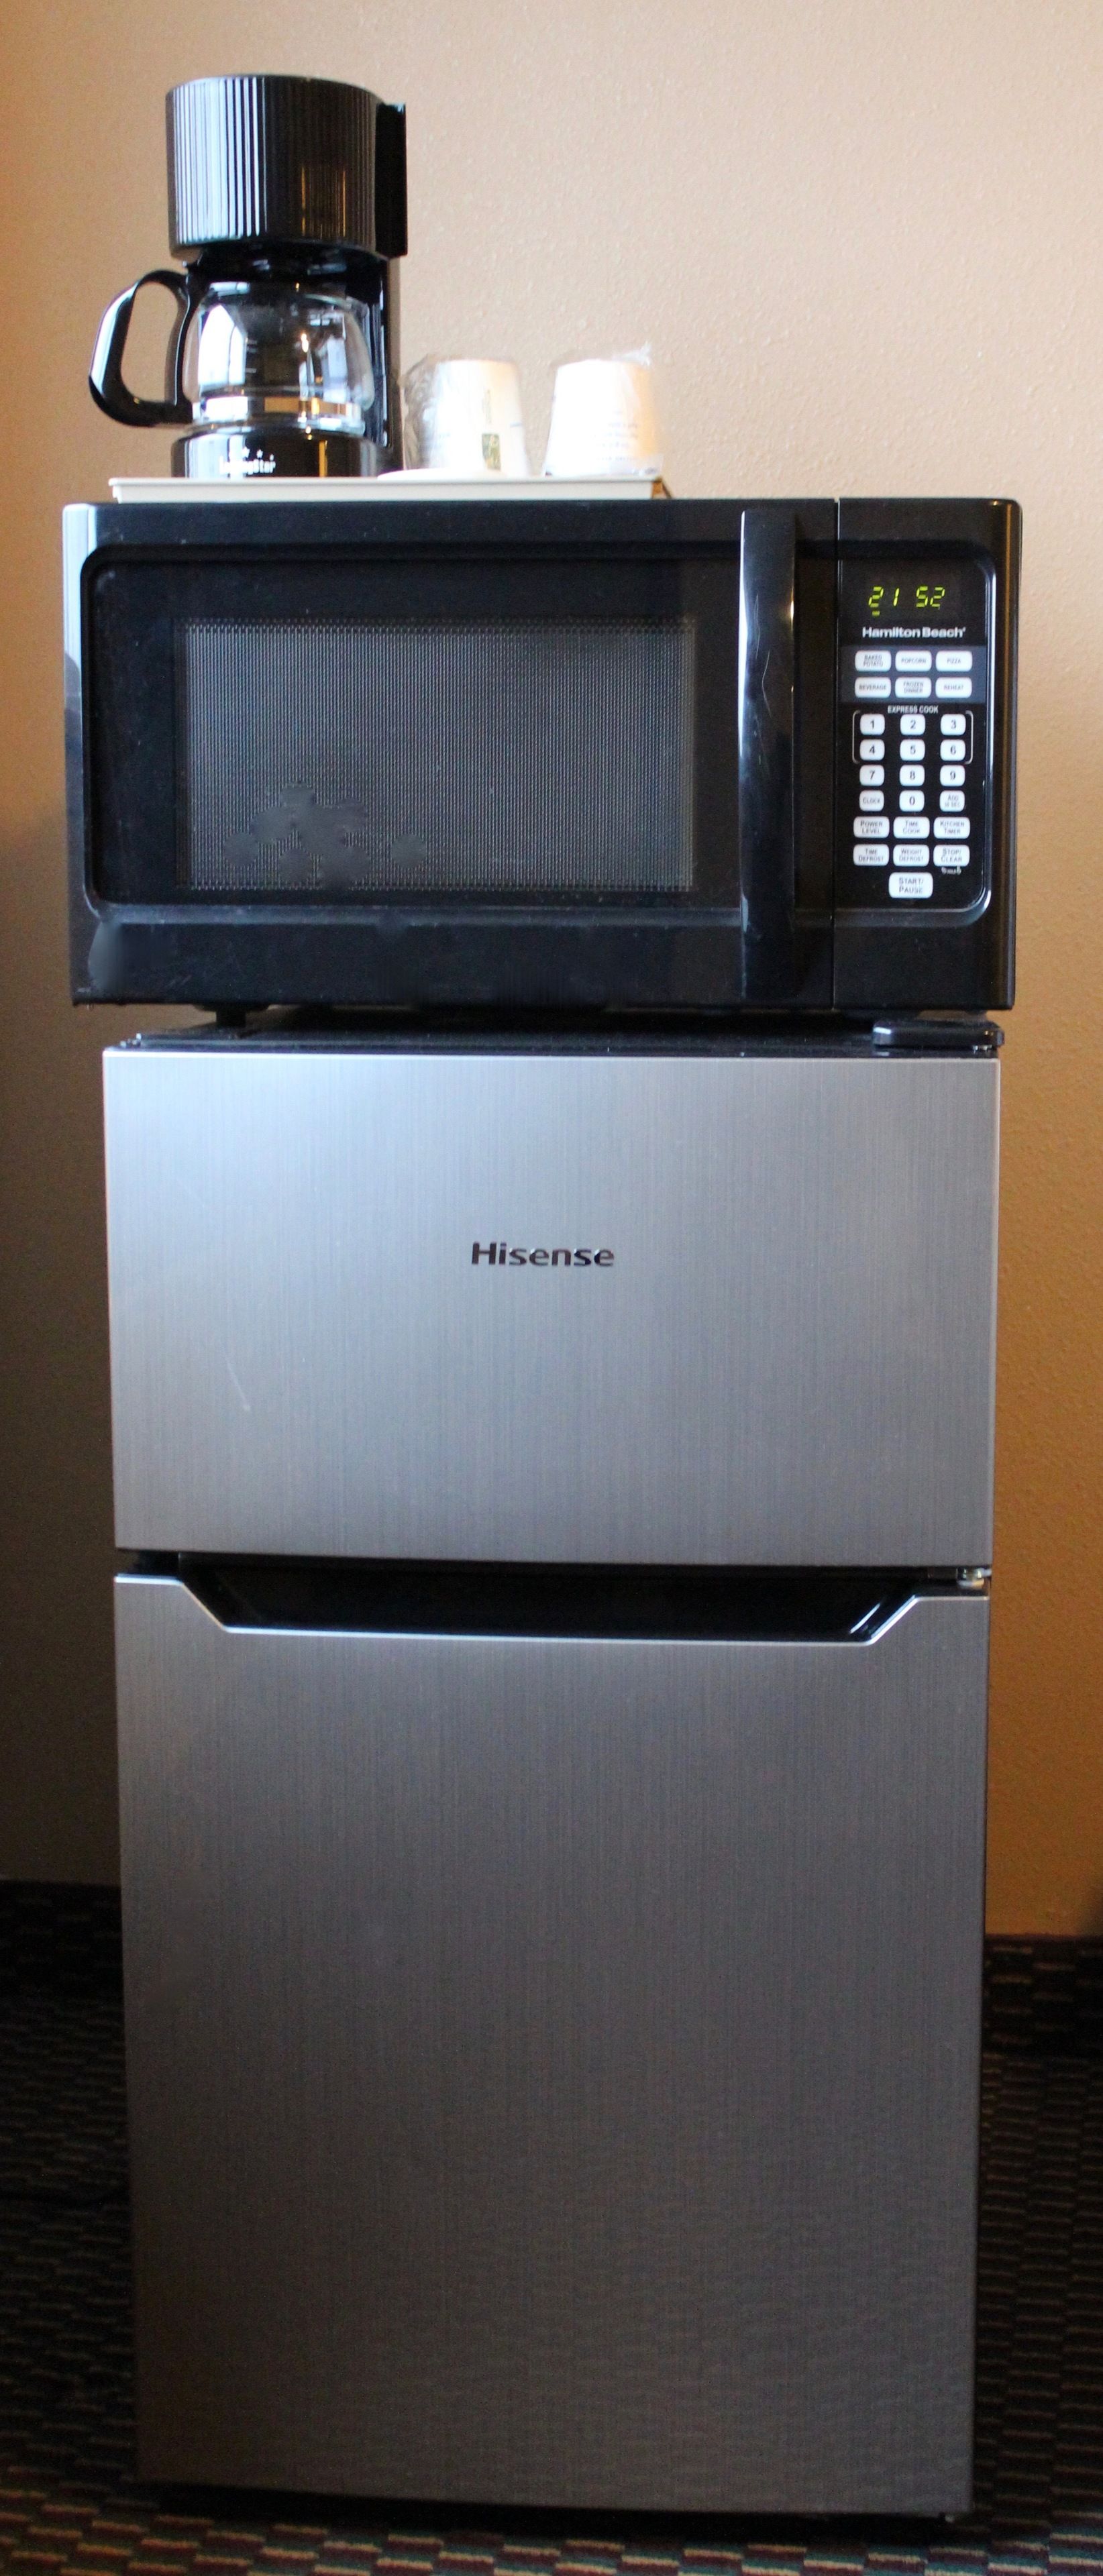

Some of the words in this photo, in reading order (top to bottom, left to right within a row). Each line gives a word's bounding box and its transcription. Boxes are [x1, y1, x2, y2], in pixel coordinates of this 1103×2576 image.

[868, 586, 900, 608] 21
[916, 586, 946, 608] 52
[862, 627, 921, 638] Hamilton
[922, 627, 963, 638] Beach
[888, 705, 918, 714] EXPRESS
[919, 705, 939, 714] COOK
[870, 720, 876, 729] 1
[910, 720, 916, 729] 2
[950, 720, 957, 729] 3
[870, 746, 876, 755] 4
[910, 746, 916, 755] 5
[950, 746, 957, 755] 6
[870, 771, 876, 780] 7
[910, 771, 916, 780] 8
[950, 771, 957, 780] 9
[909, 796, 916, 806] 0
[471, 1242, 615, 1267] Hisense
